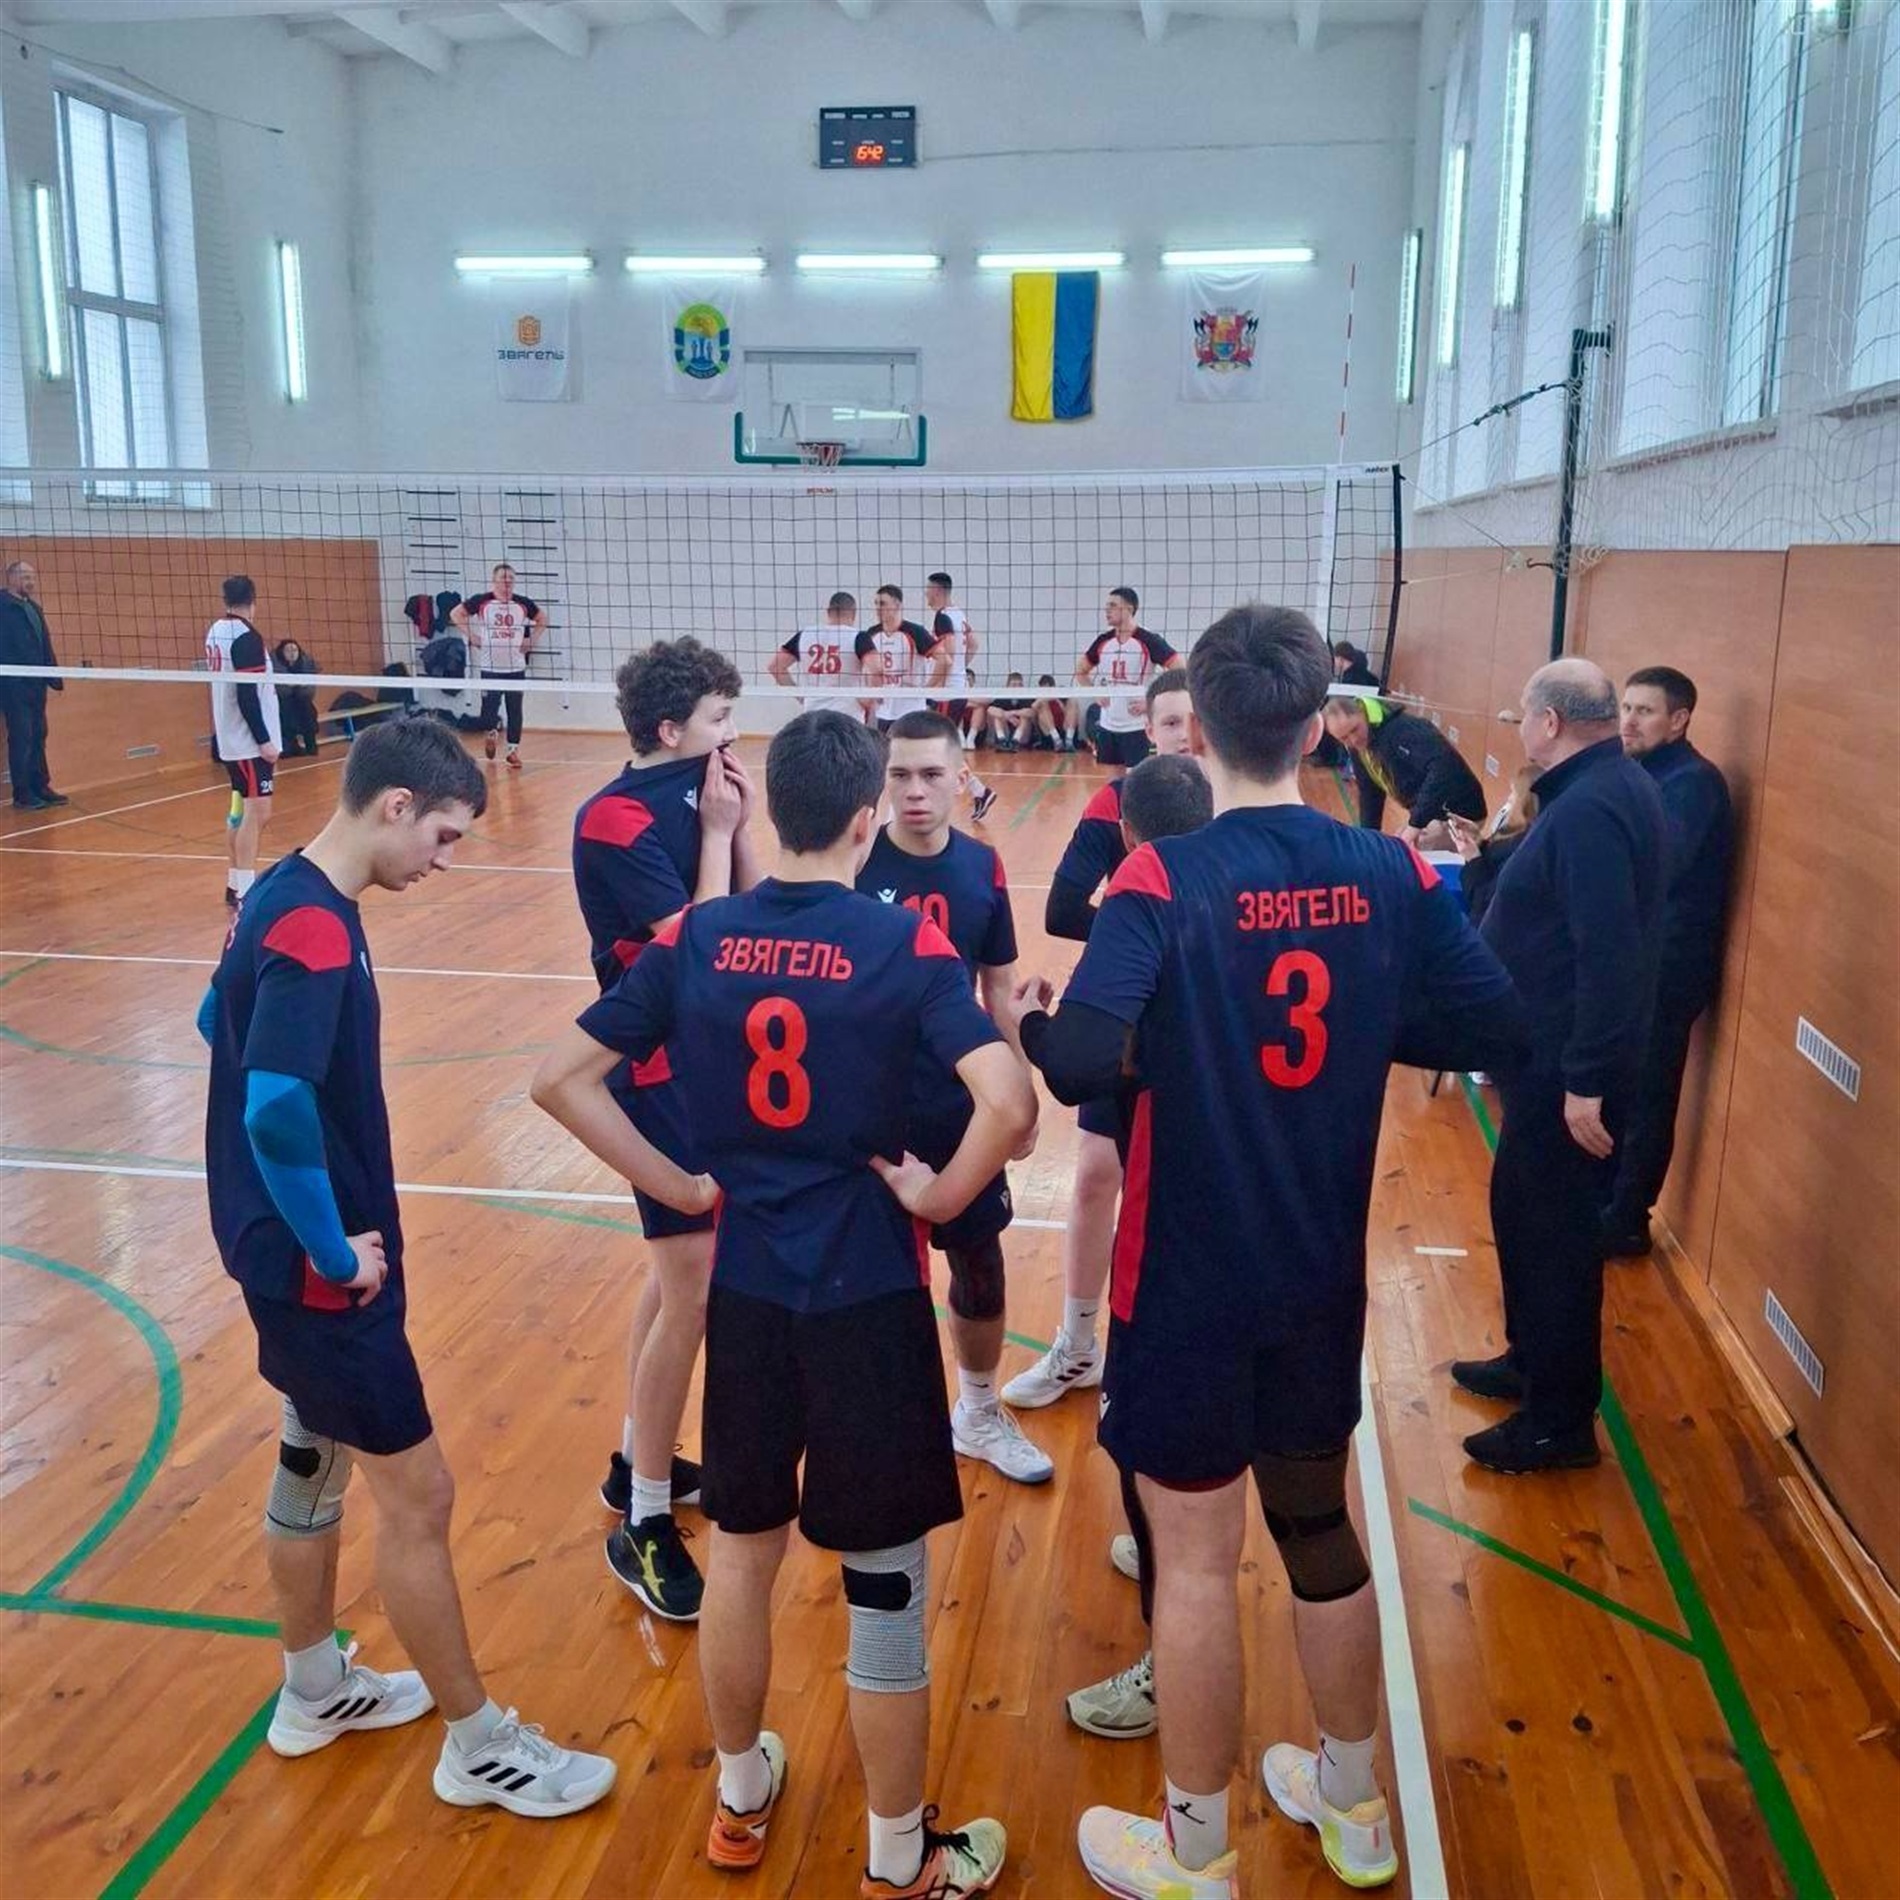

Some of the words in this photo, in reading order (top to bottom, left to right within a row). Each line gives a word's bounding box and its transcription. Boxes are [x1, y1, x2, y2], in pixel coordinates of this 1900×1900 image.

[494, 613, 514, 627] 30
[807, 643, 842, 675] 25
[1112, 660, 1127, 680] 11
[1236, 885, 1370, 931] ЗВЯГЕЛЬ
[714, 937, 853, 981] ЗВЯГЕЛЬ
[1261, 949, 1331, 1088] 3
[745, 996, 811, 1128] 8
